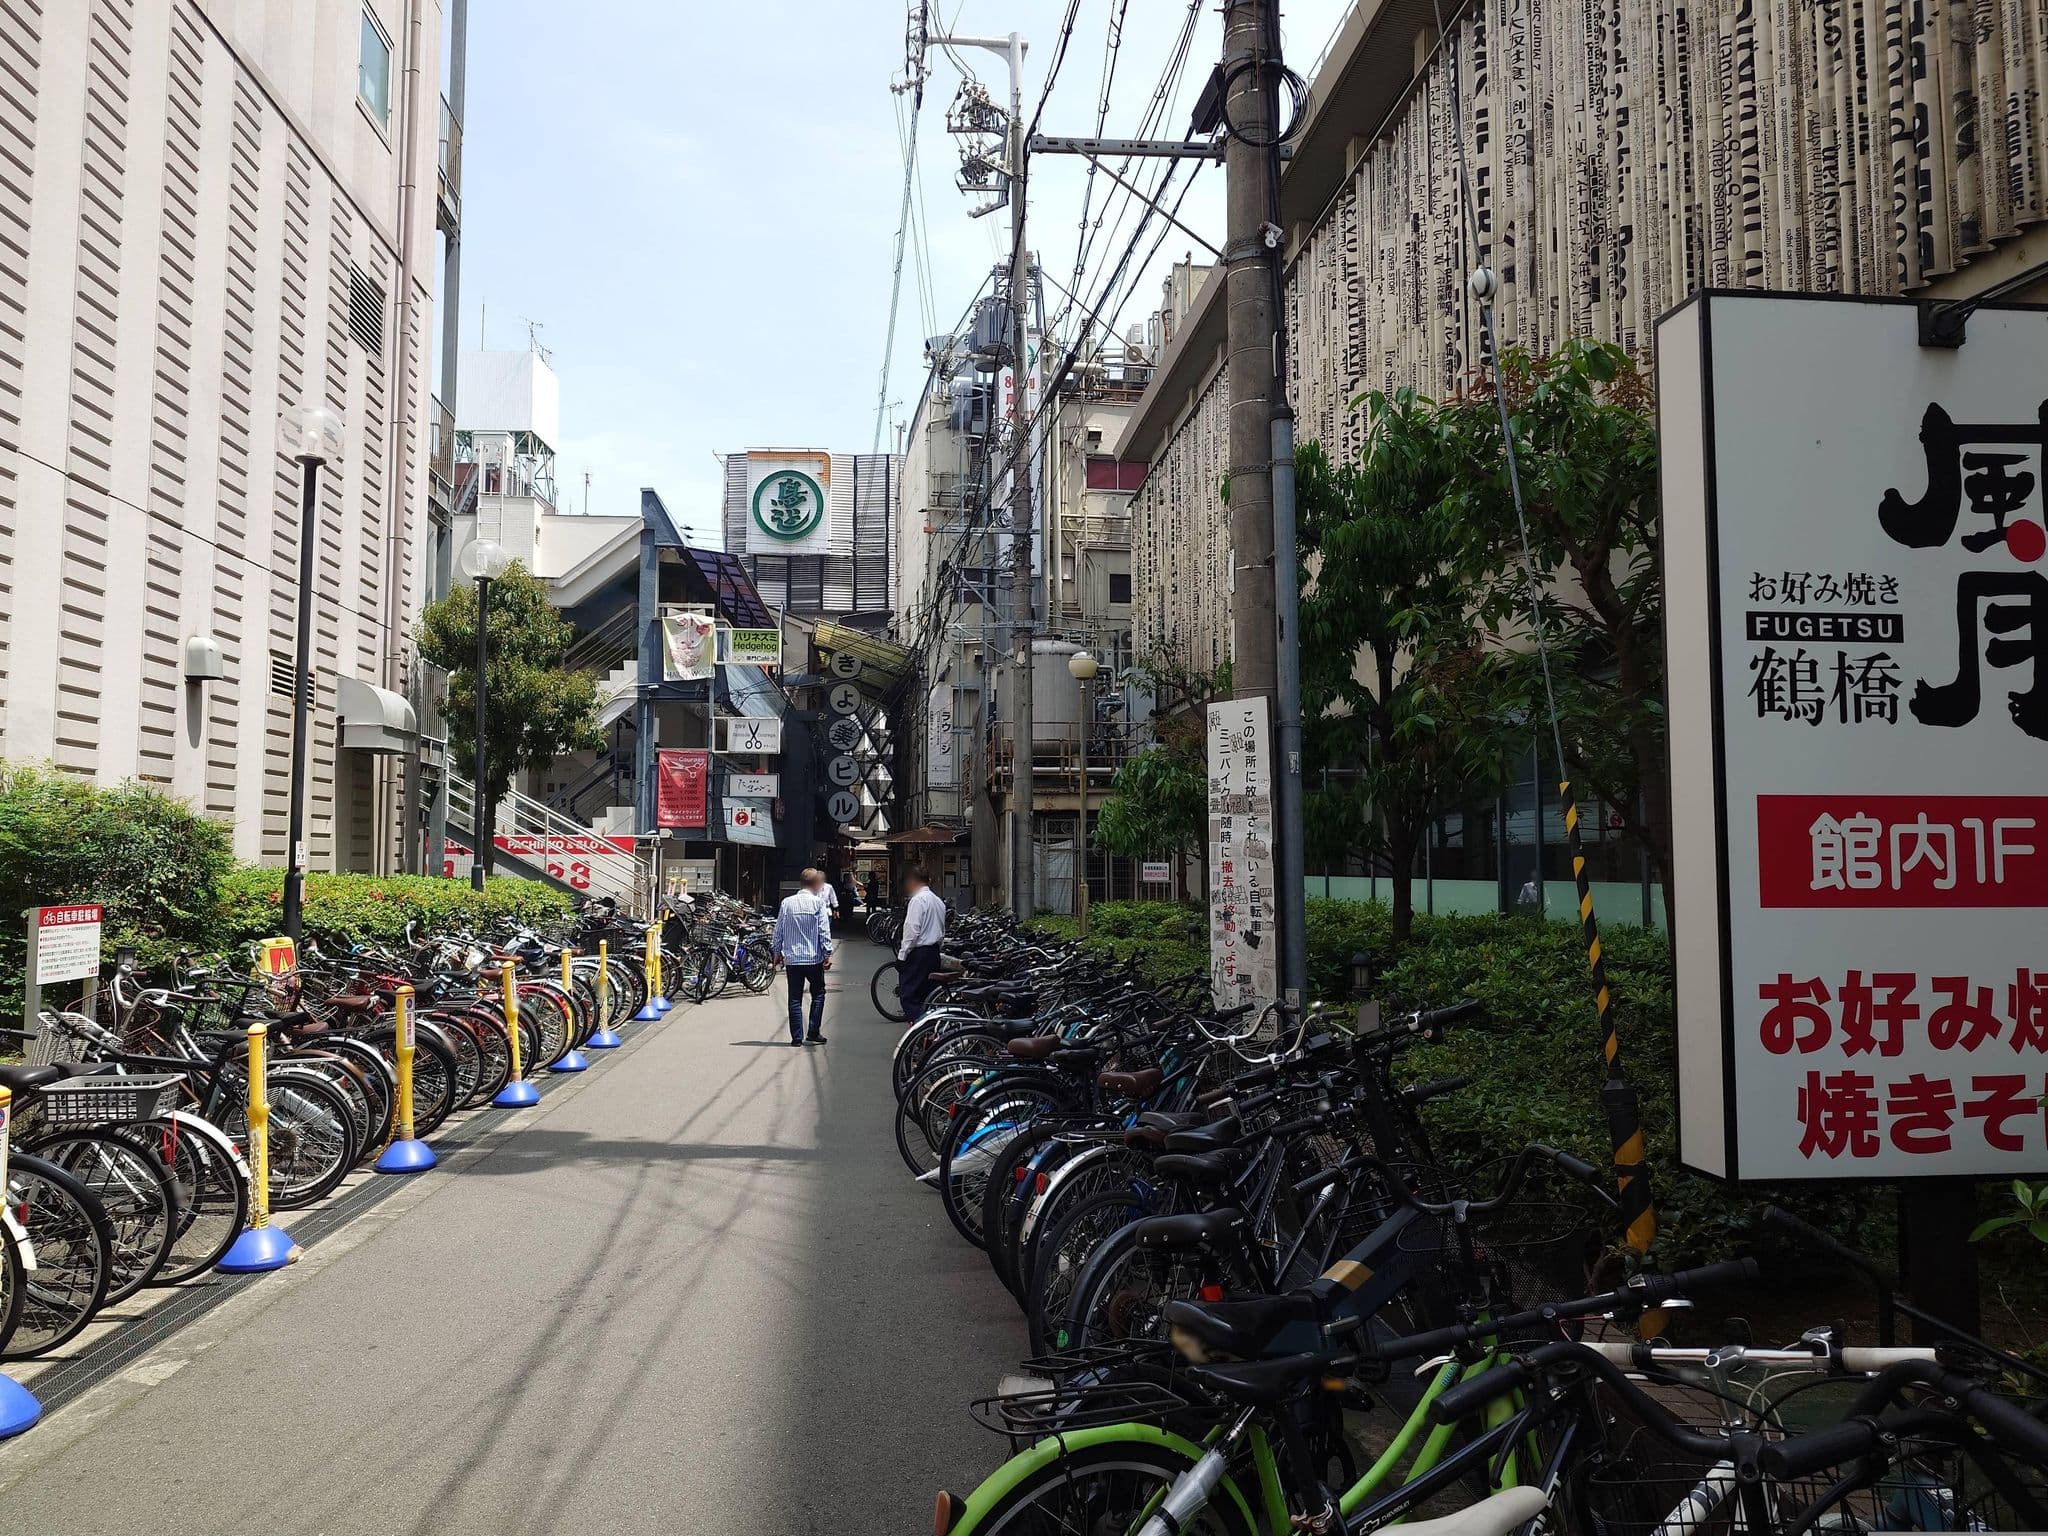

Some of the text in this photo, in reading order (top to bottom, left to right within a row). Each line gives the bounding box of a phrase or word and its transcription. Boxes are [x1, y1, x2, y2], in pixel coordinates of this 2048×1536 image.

[1794, 227, 1803, 276] Constitution
[1388, 272, 1396, 296] STORY
[1385, 350, 1396, 368] For
[1748, 571, 1900, 606] お好み焼き
[734, 632, 777, 642] ハリネズミ
[1754, 616, 1894, 639] FUGETSU
[733, 642, 777, 652] Hedgehog
[1747, 646, 1903, 727] 鶴橋
[1809, 811, 2036, 890] 館内1F
[1797, 1069, 2048, 1160] 焼きそ
